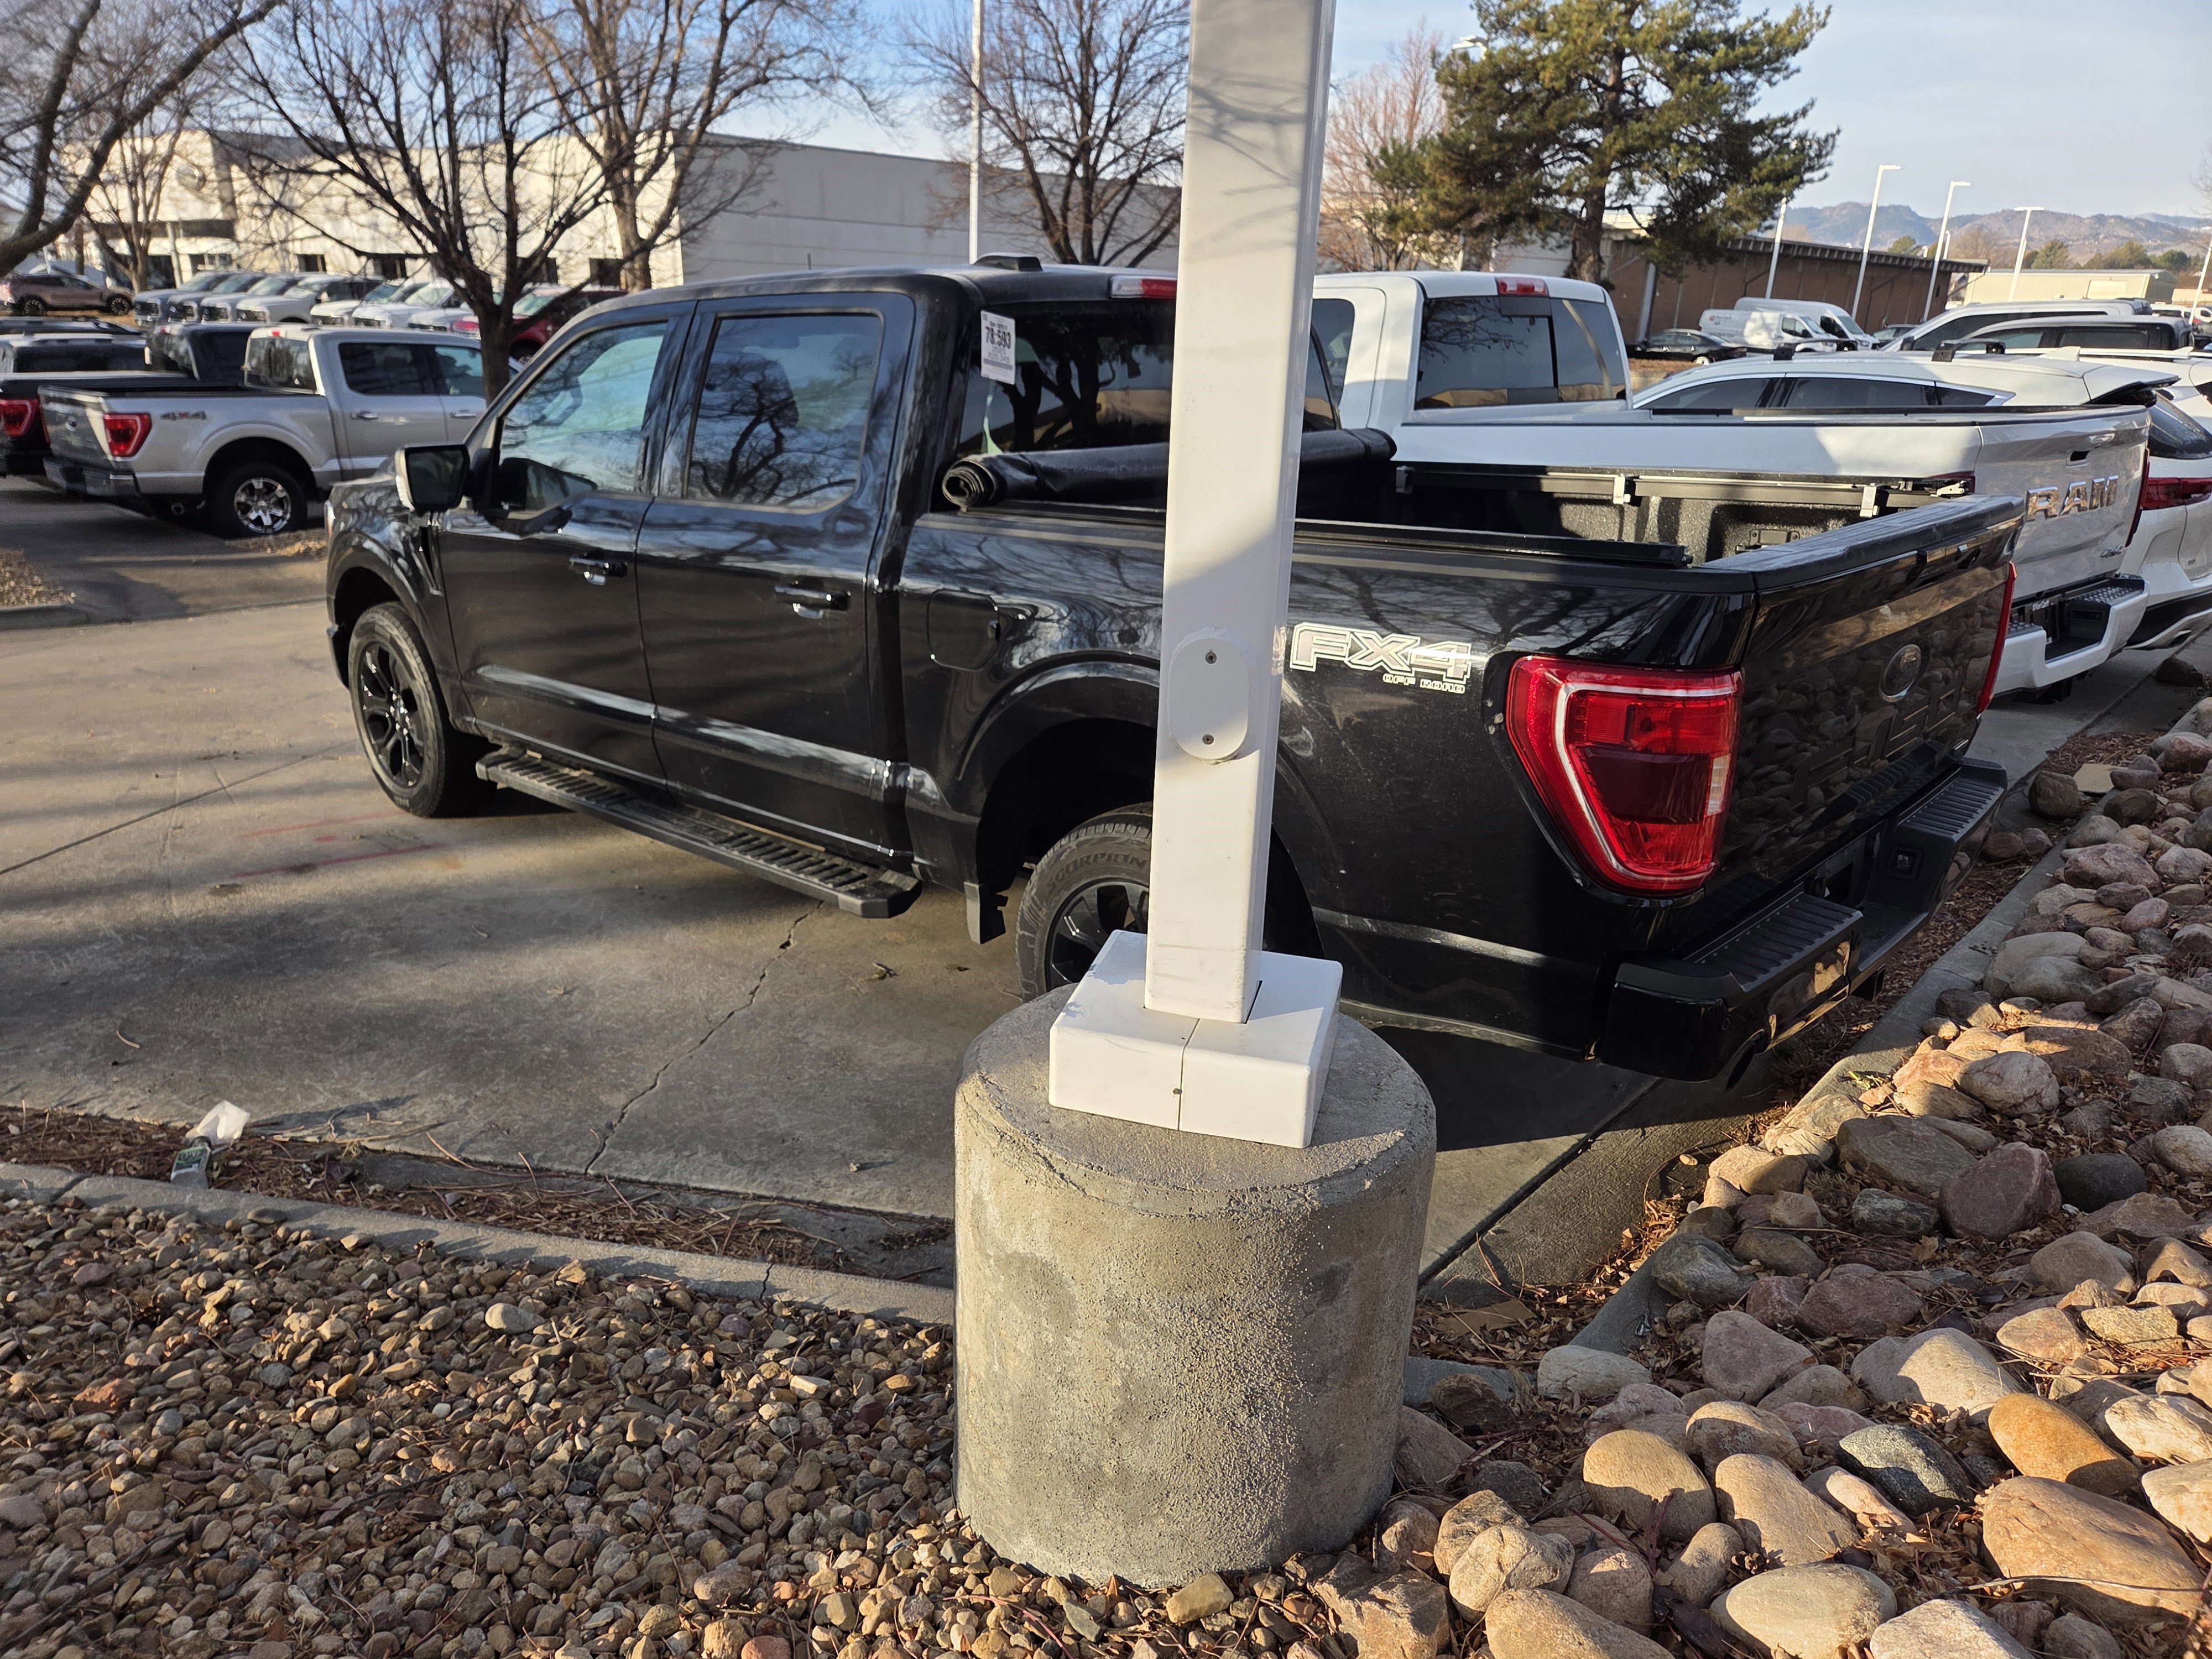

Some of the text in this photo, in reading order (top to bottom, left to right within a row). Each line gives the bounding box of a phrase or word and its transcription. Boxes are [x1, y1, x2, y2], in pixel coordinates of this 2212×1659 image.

[2024, 475, 2119, 522] RAM
[1290, 622, 1472, 684] FX4
[1383, 673, 1465, 694] OFF ROAD
